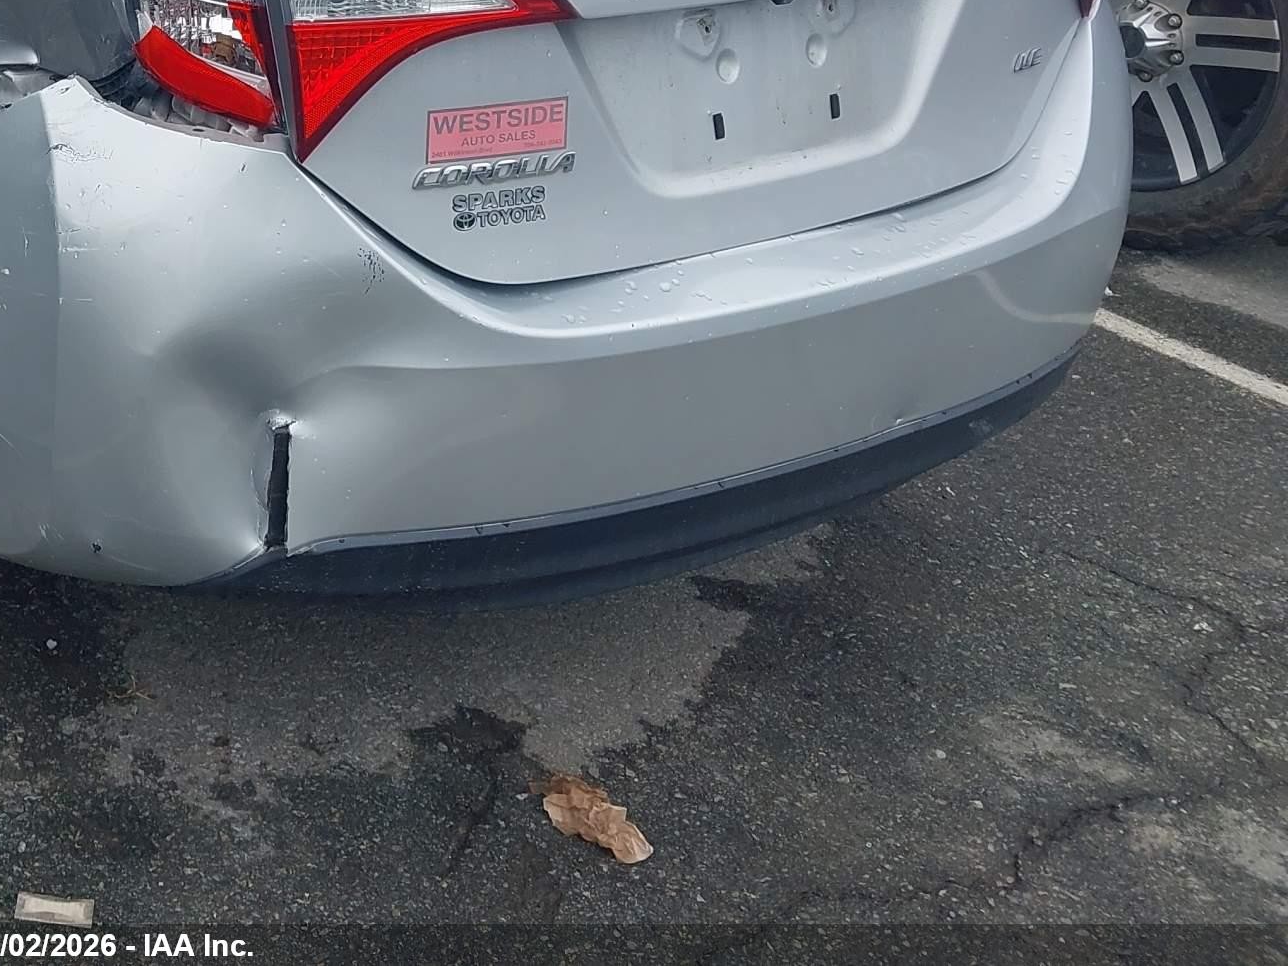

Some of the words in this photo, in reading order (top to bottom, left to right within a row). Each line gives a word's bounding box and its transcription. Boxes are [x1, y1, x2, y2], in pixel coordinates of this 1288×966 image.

[433, 104, 563, 135] WESTSIDE
[461, 134, 495, 147] AUTO
[498, 130, 536, 143] SALES
[412, 151, 576, 190] COROLLA
[452, 186, 545, 212] SPARKS
[476, 205, 546, 227] TOYOTA
